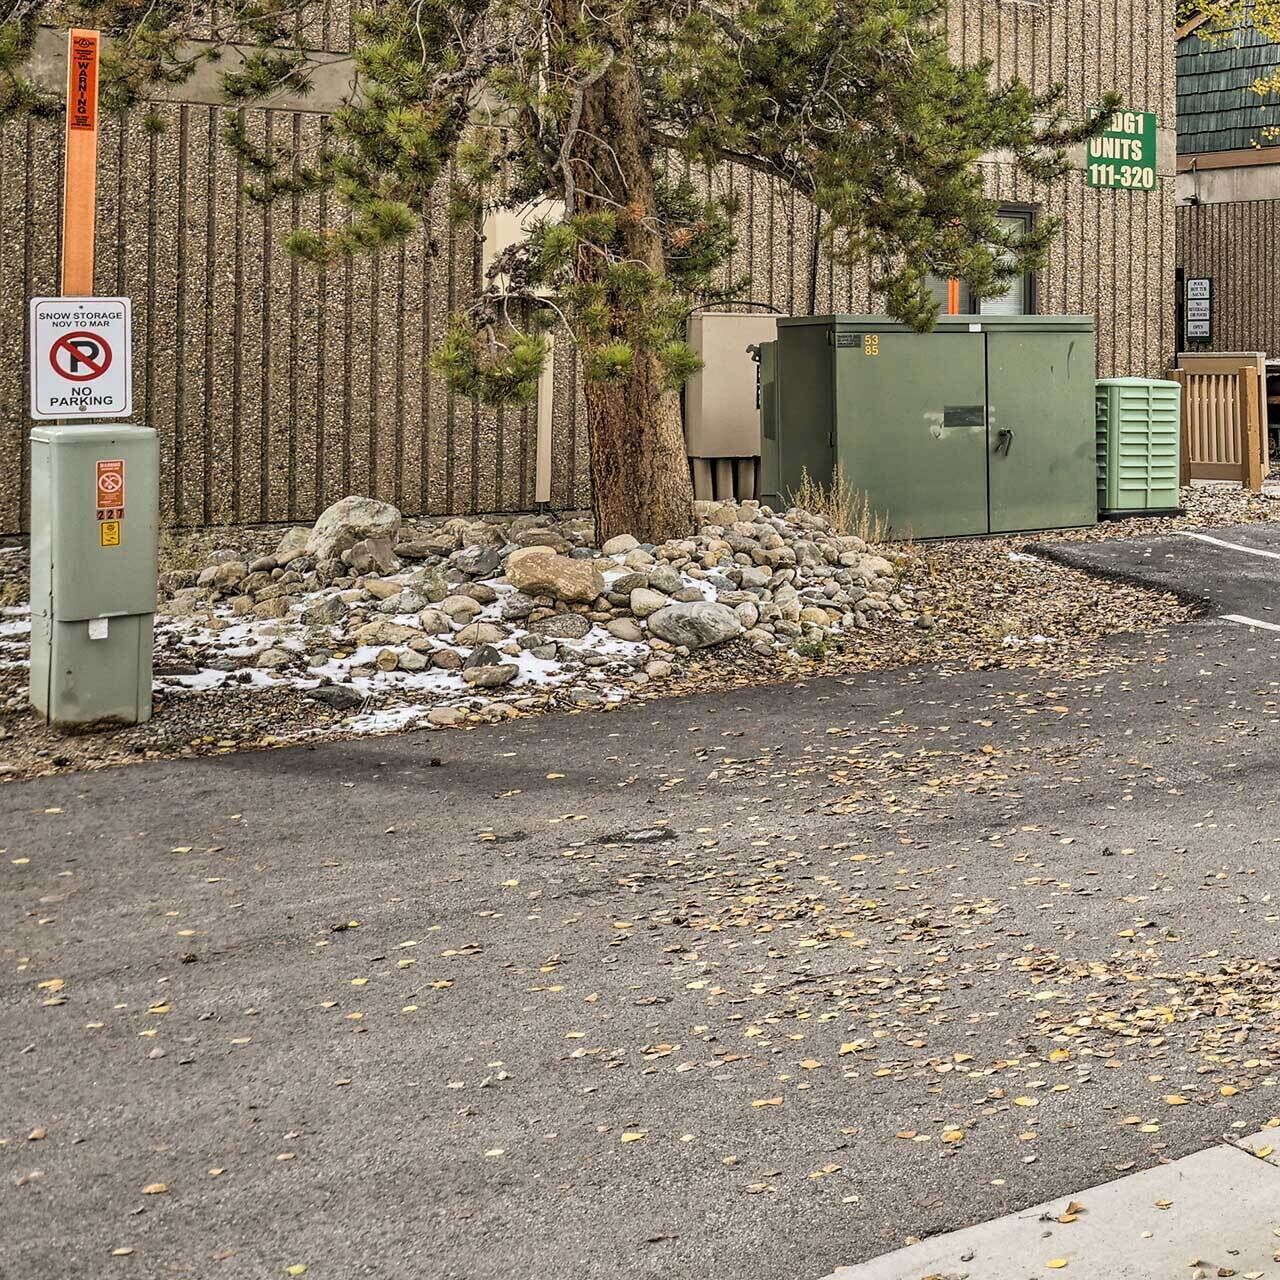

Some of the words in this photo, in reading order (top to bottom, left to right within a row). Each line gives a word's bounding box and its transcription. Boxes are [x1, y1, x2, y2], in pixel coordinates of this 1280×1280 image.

[77, 62, 89, 114] WARNING
[1091, 109, 1144, 135] DG1
[1090, 137, 1142, 161] UNITS
[1089, 164, 1154, 188] 111-320
[39, 312, 71, 320] SNOW
[73, 312, 123, 320] STORAGE
[864, 334, 879, 345] 53
[864, 345, 879, 355] 85
[71, 387, 92, 396] NO
[50, 396, 113, 407] PARKING
[97, 509, 124, 520] 227
